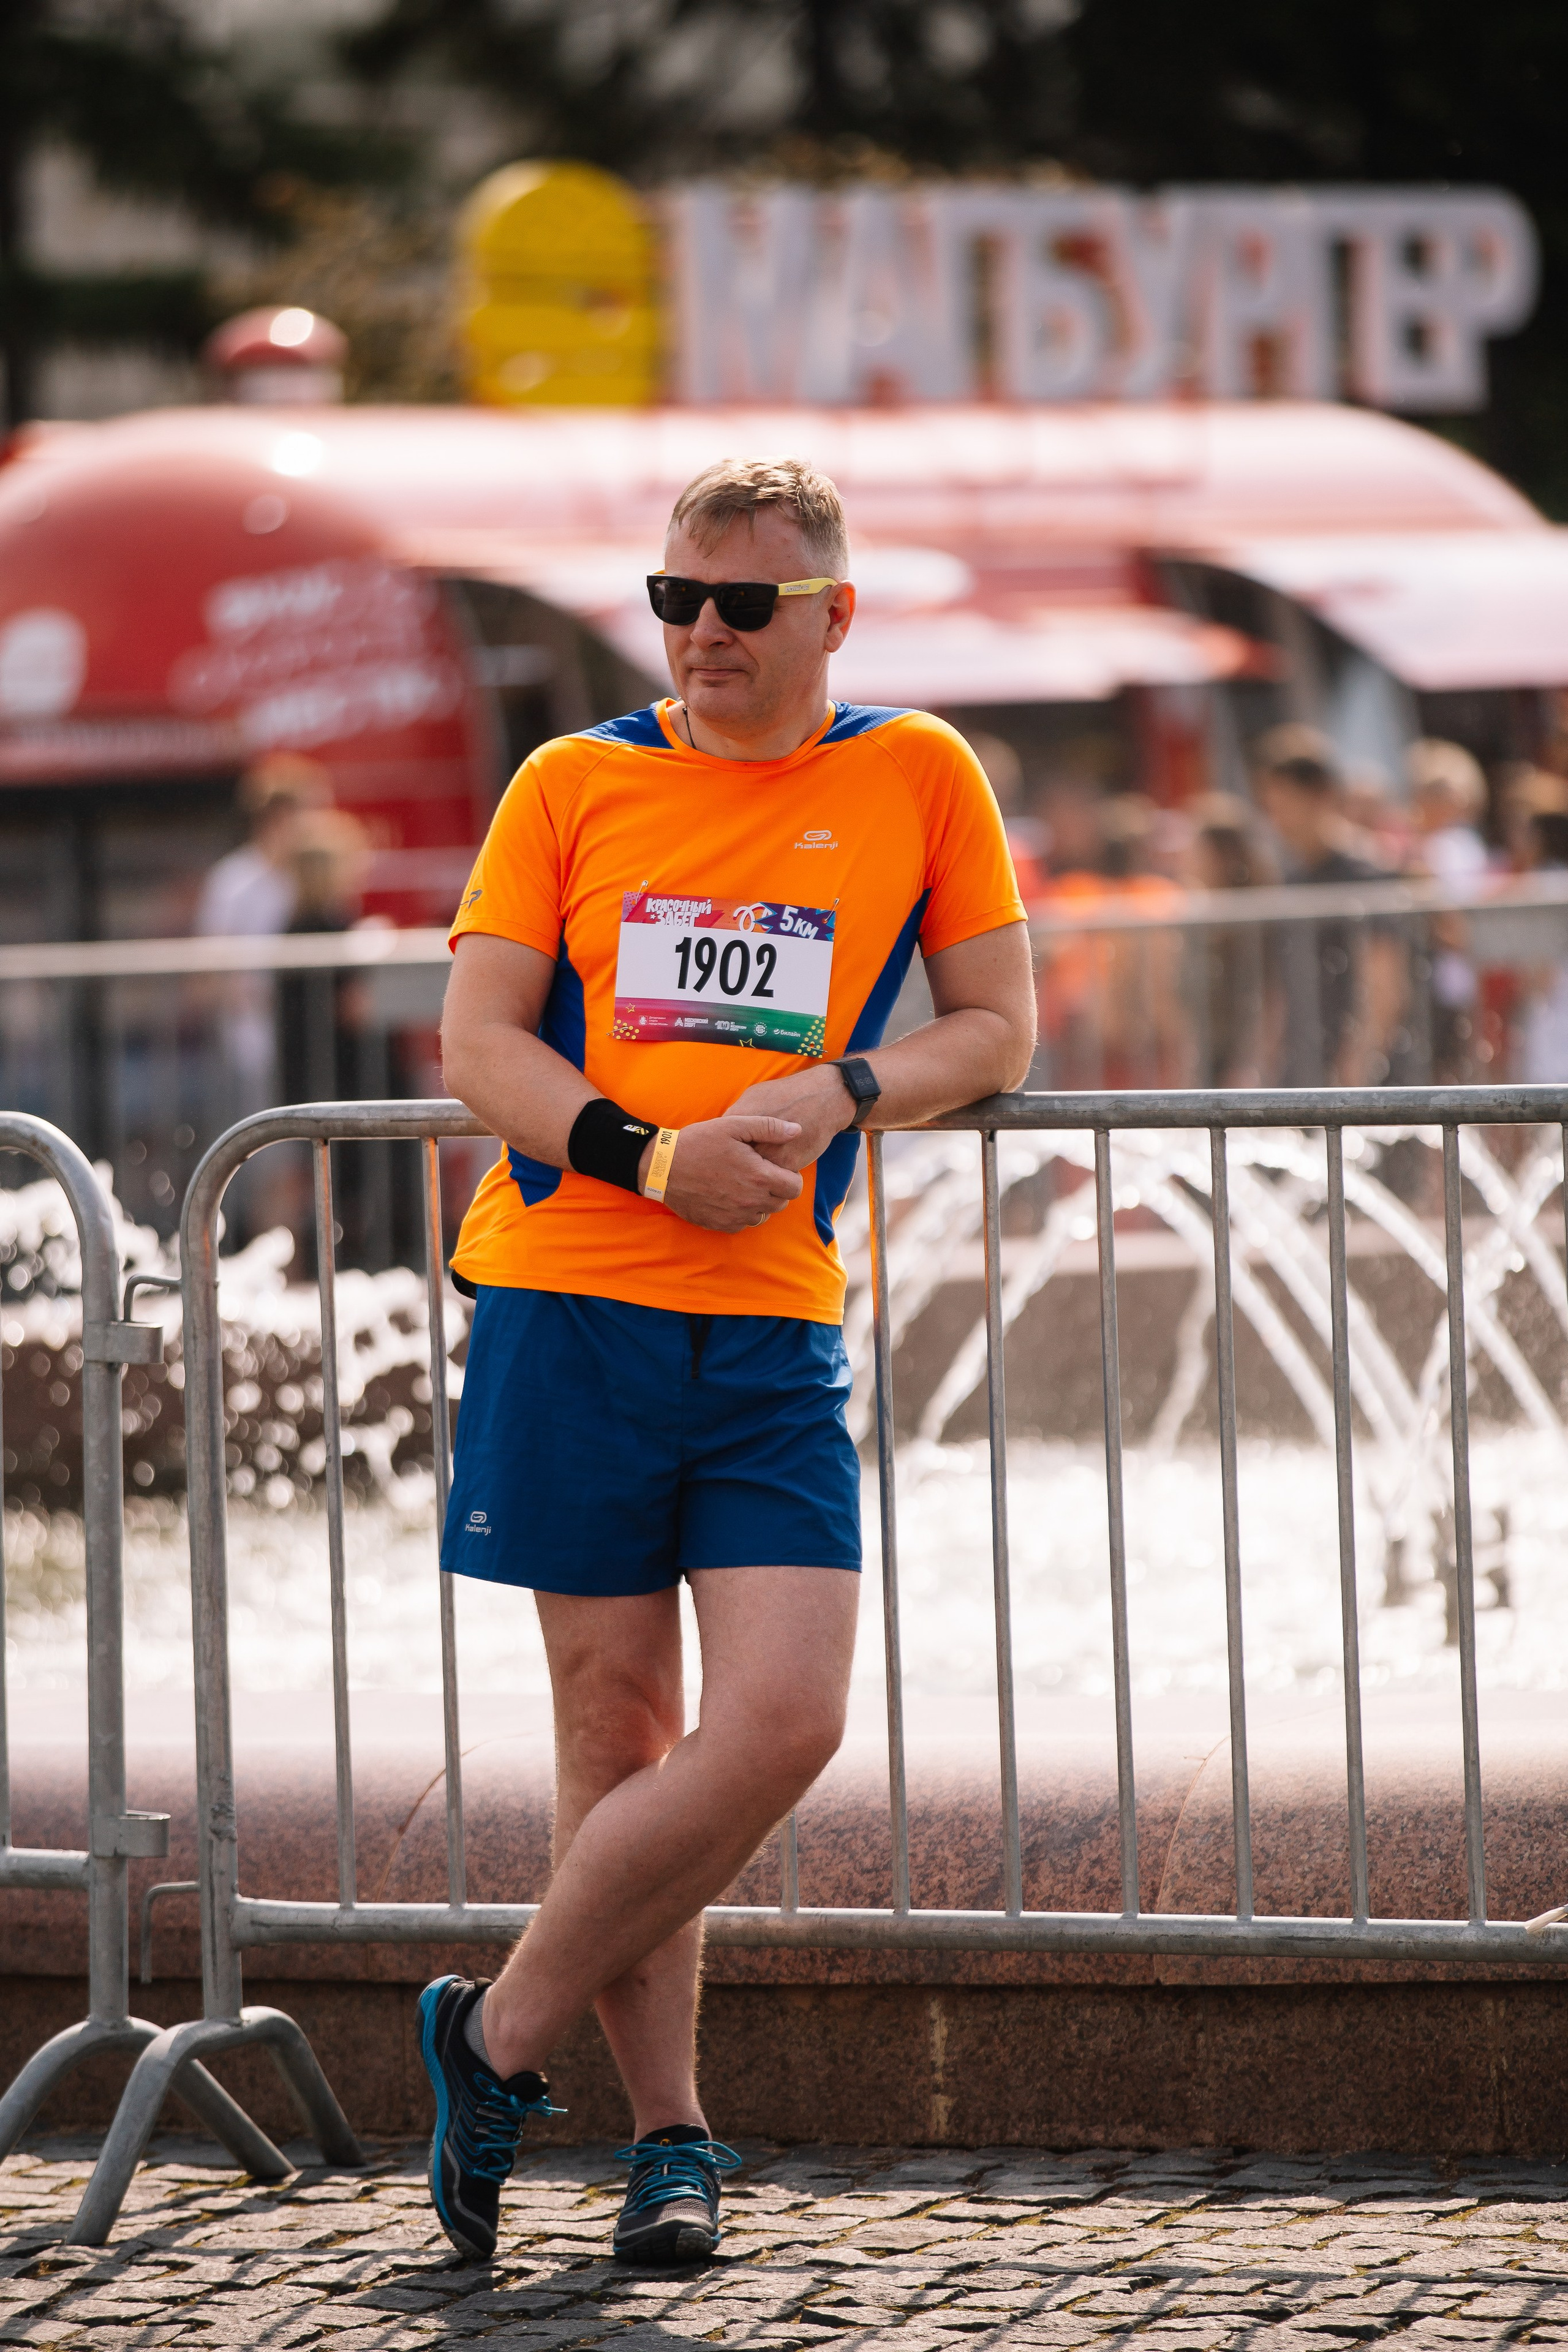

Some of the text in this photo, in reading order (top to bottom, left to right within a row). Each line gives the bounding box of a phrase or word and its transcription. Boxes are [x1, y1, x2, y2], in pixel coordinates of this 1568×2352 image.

[794, 842, 839, 850] Kalenji
[646, 898, 712, 915] КРАСОЧНЫЙ
[655, 910, 701, 927] ЗАБЕГ
[780, 905, 799, 932] 5
[674, 936, 777, 998] 1902
[660, 1131, 673, 1145] 1902
[465, 1523, 491, 1536] Kalenji
